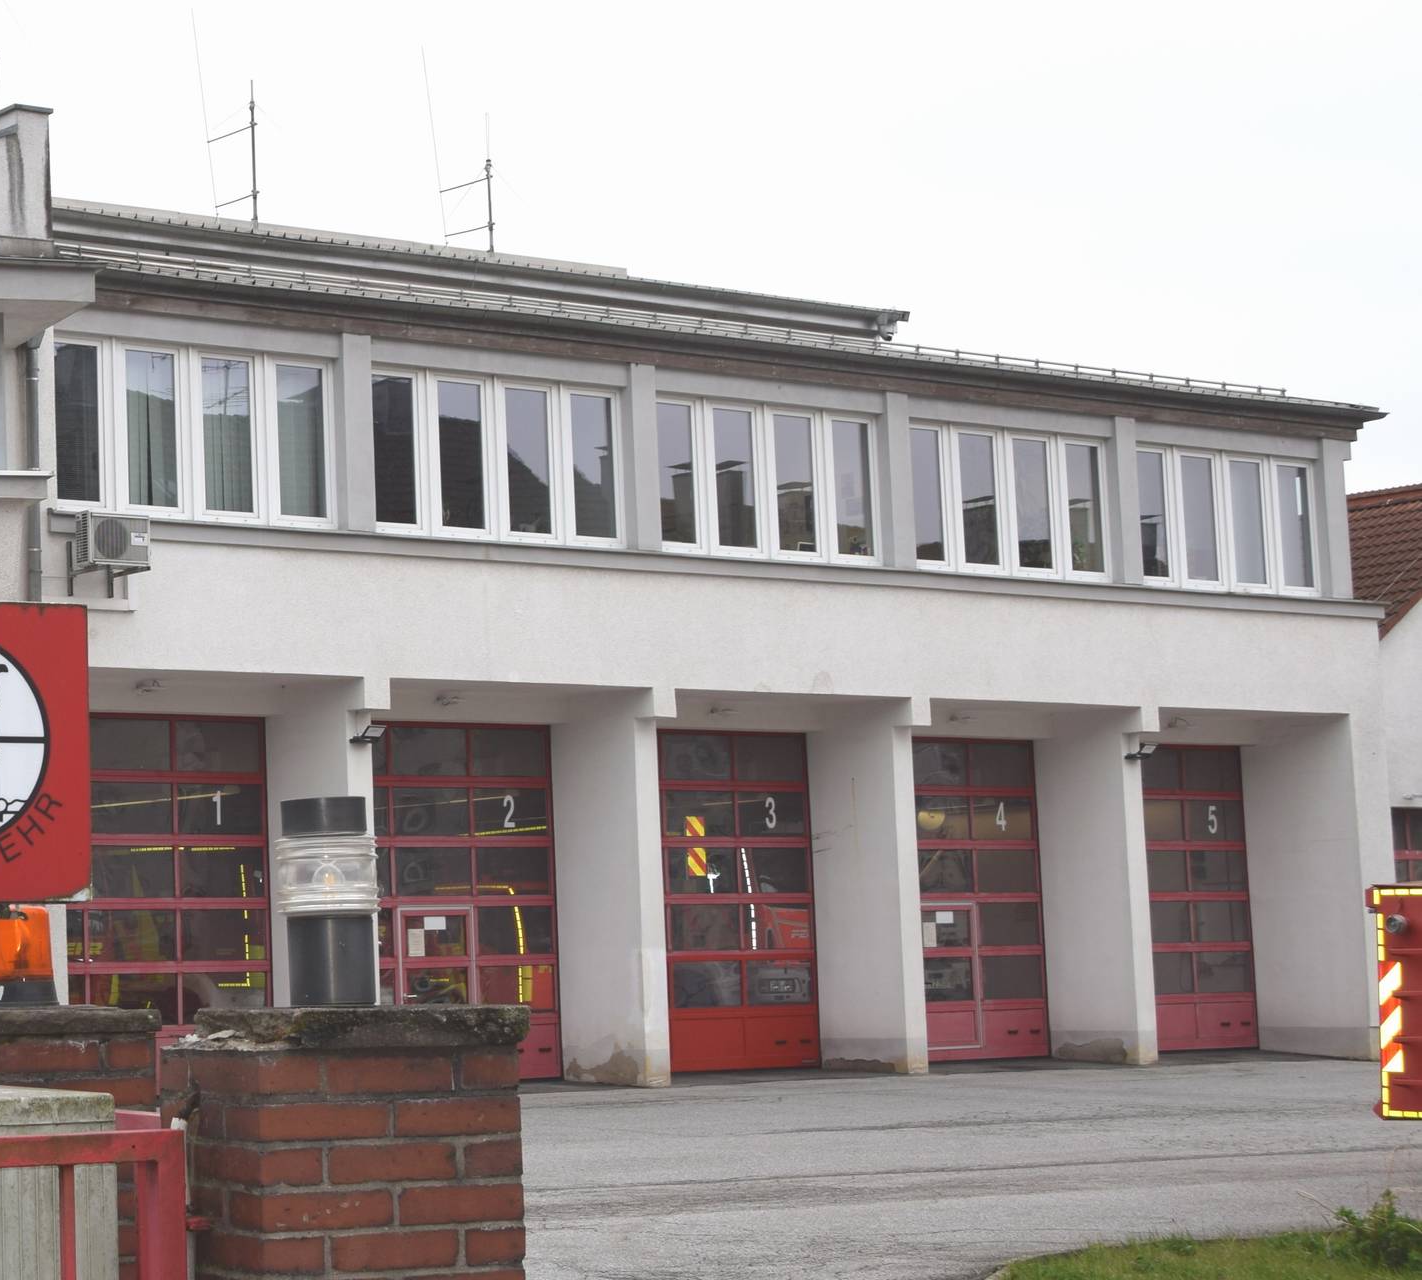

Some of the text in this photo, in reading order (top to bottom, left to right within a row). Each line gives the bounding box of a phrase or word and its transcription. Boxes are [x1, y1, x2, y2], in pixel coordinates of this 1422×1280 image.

[211, 790, 223, 826] 1
[503, 794, 516, 828] 2
[765, 797, 777, 830] 3
[995, 802, 1007, 831] 4
[1208, 805, 1218, 834] 5
